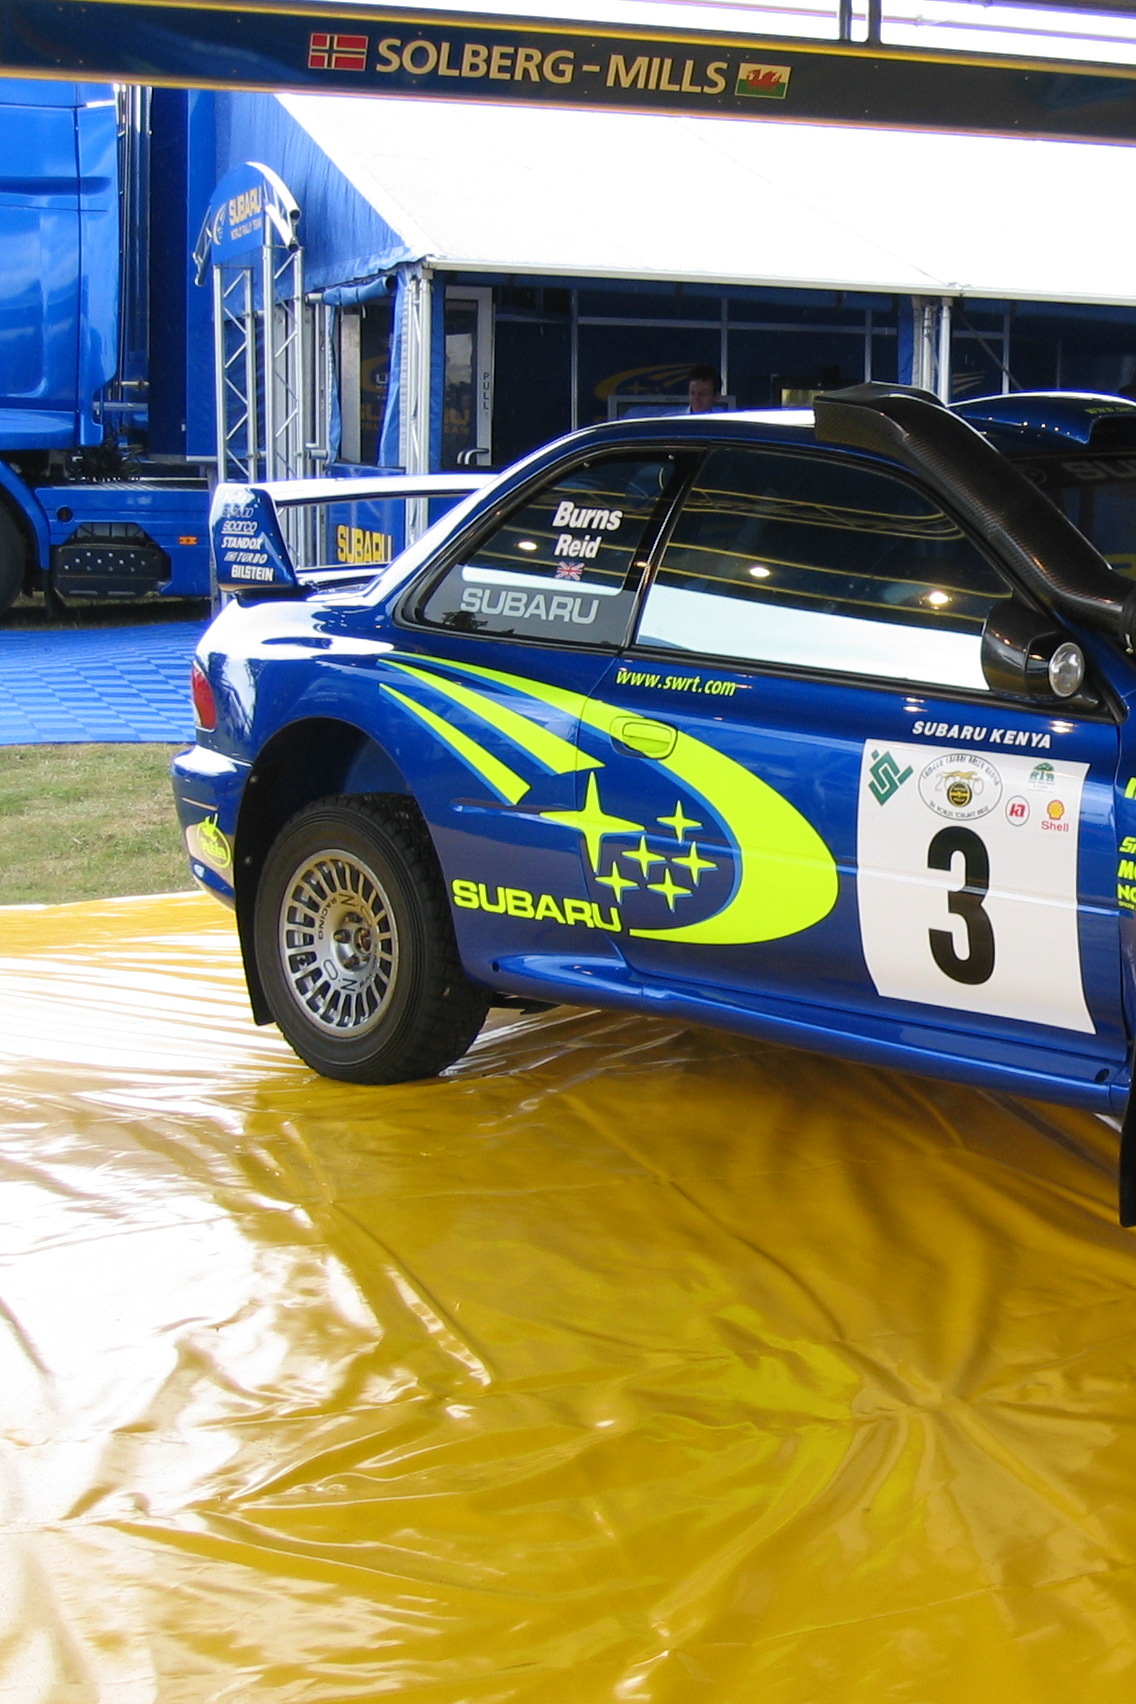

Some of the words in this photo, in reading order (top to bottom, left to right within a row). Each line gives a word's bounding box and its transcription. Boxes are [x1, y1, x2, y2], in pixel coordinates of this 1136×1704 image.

[552, 501, 623, 531] Burns
[221, 536, 264, 550] STANDOX
[554, 533, 602, 558] Reid
[231, 564, 274, 582] BILSTEIN
[460, 588, 599, 624] SUBARU
[616, 670, 736, 696] www.swrt.com
[912, 720, 987, 742] SUBARU
[989, 727, 1052, 749] KENYA
[1041, 820, 1069, 832] Shell
[451, 878, 624, 933] SUBARU
[927, 826, 995, 985] 3
